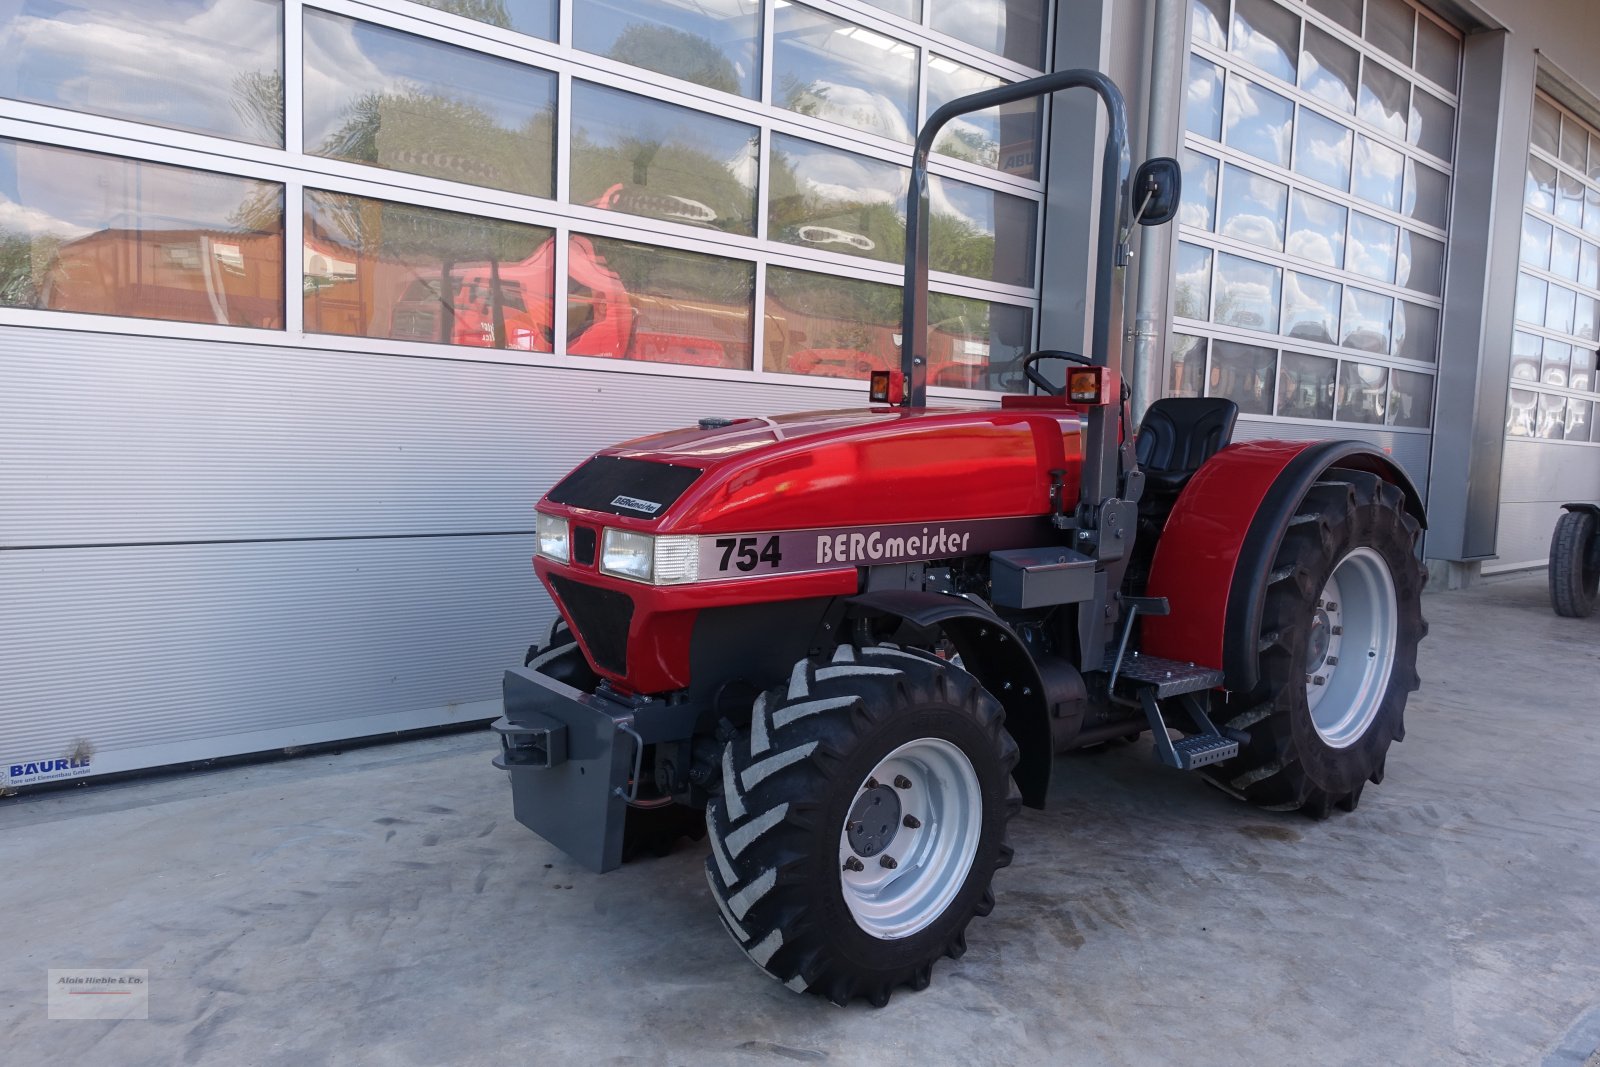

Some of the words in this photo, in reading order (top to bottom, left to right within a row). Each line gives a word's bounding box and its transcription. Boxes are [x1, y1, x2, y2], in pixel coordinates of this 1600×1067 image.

[716, 536, 782, 571] 754
[816, 527, 970, 564] BERGmeister
[10, 756, 90, 777] BÄURLE
